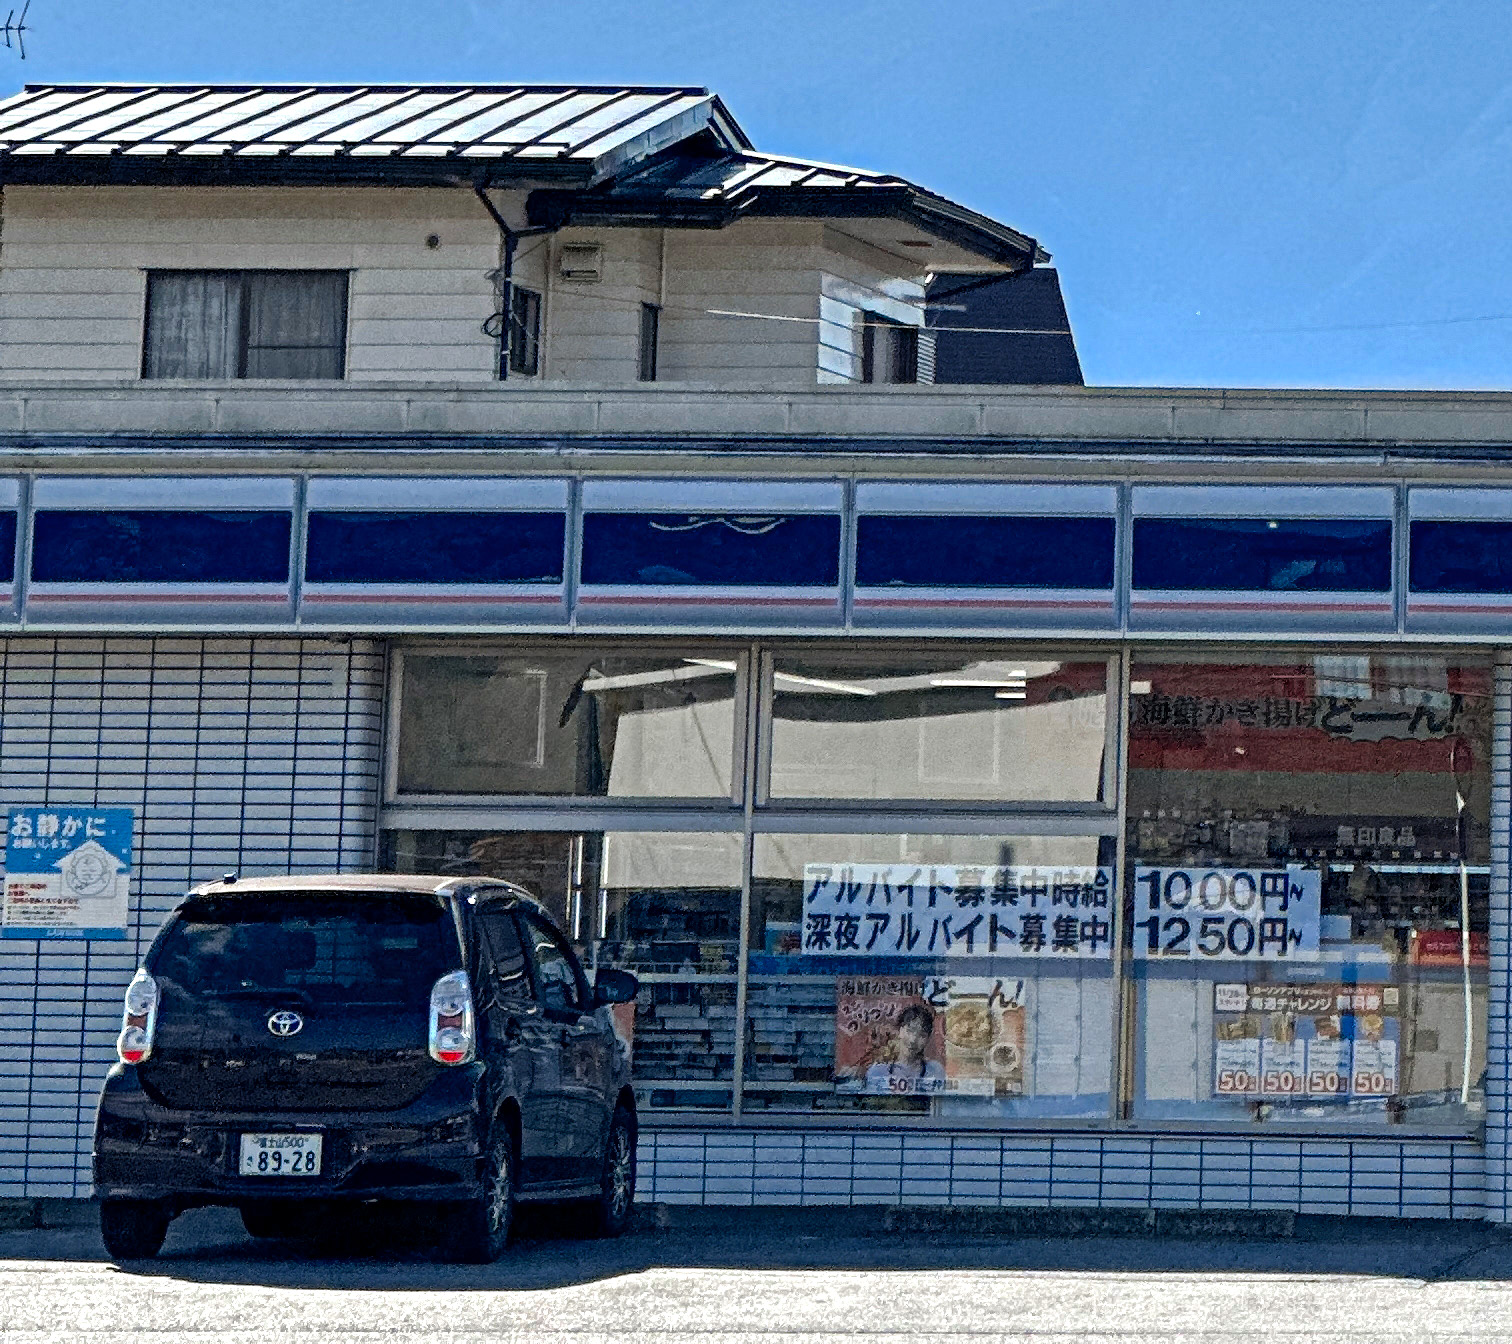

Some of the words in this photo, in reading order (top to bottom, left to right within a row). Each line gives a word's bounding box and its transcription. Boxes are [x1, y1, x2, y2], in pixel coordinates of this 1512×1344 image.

[11, 814, 106, 837] お静かに
[1337, 826, 1416, 846] 無印良品
[806, 867, 1109, 909] アルバイト募集中時給
[805, 912, 1109, 954] 深夜アルバイト募集中
[258, 1151, 315, 1172] 89-28
